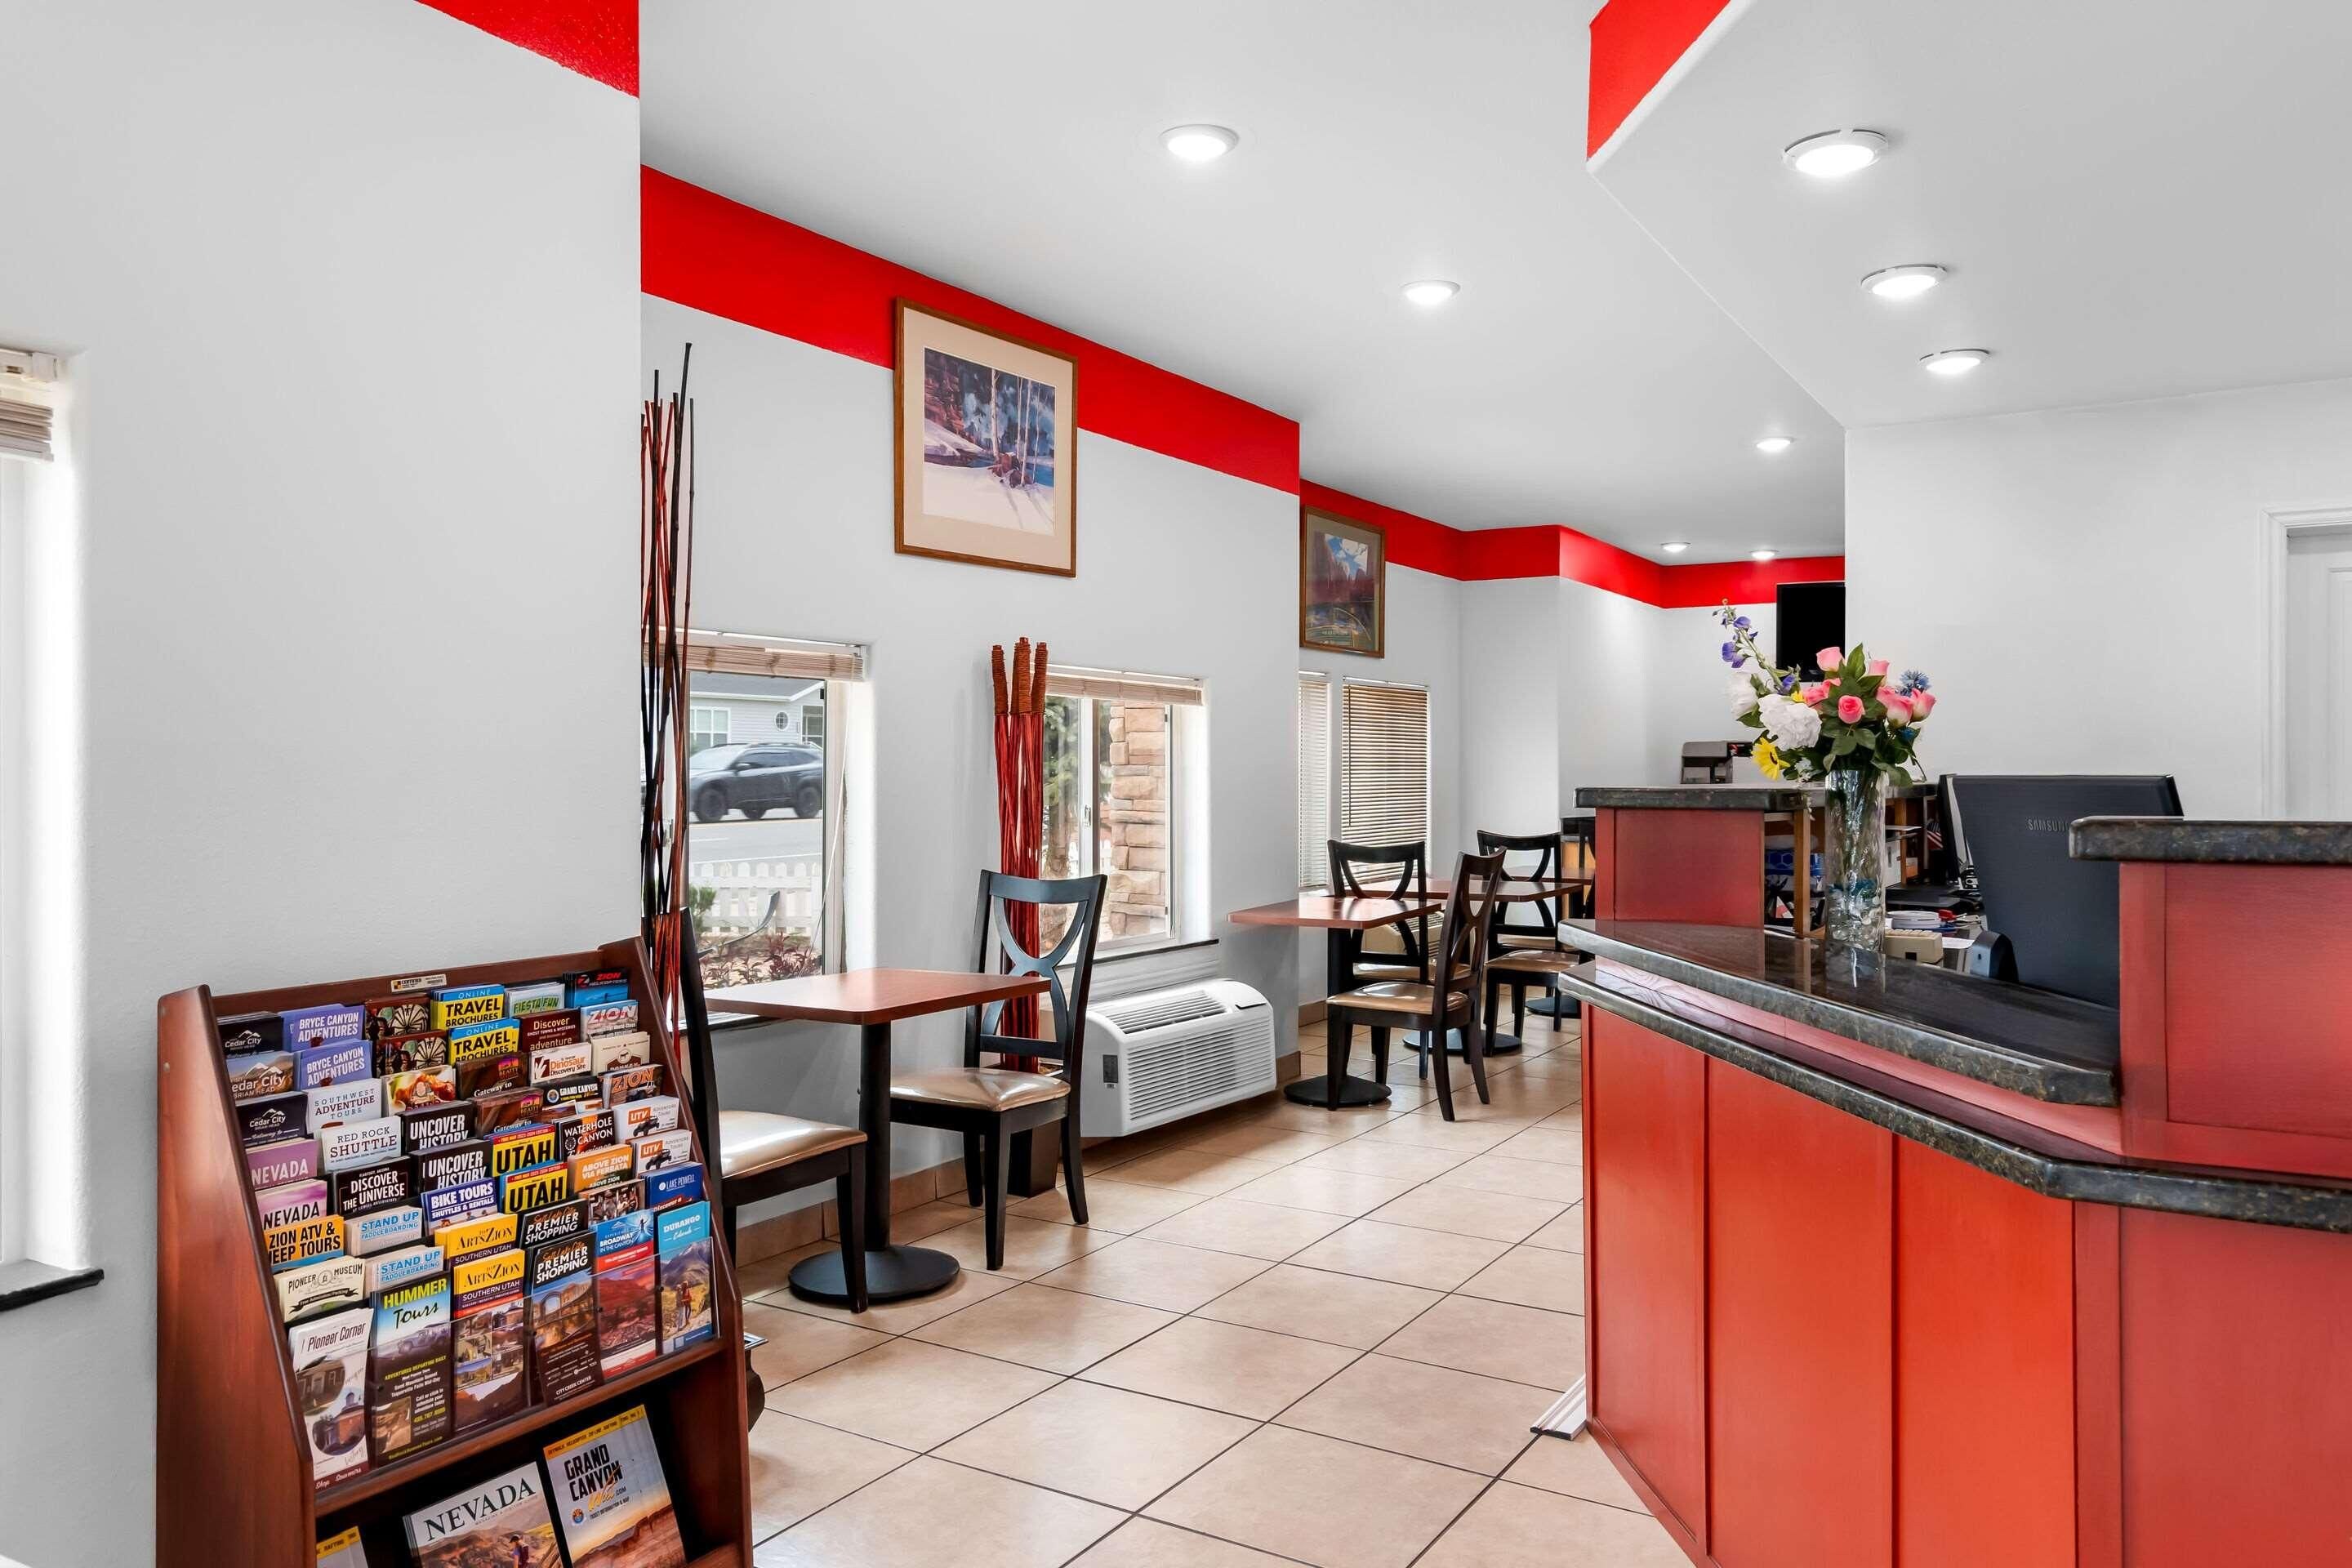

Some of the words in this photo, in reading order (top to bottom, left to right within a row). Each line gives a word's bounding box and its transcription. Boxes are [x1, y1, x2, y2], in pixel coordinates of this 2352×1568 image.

[596, 972, 621, 980] ZION
[459, 989, 490, 999] ONLINE
[446, 998, 500, 1017] TRAVEL
[514, 998, 541, 1013] FIESTA
[543, 997, 559, 1008] FUN
[588, 1005, 637, 1023] ZION
[299, 1016, 326, 1029] BRYCE
[327, 1012, 359, 1024] CANYON
[446, 1012, 498, 1027] BROCHURES
[466, 1022, 500, 1036] ONLINE
[533, 1018, 570, 1030] Discover
[225, 1040, 245, 1048] Cedar
[247, 1037, 261, 1045] City
[298, 1023, 358, 1042] ADVENTURES
[454, 1031, 510, 1054] TRAVEL
[455, 1045, 509, 1062] BROCHURES
[530, 1037, 572, 1051] adventure
[307, 1059, 332, 1074] BRYCE
[332, 1046, 363, 1064] CANYON
[550, 1057, 585, 1069] Dinosaur
[307, 1058, 365, 1086] ADVENTURES
[550, 1067, 575, 1076] Discovery
[613, 1067, 653, 1093] ZION
[232, 1080, 259, 1092] edar
[261, 1075, 286, 1087] City
[256, 1086, 276, 1095] HEAD
[474, 1084, 503, 1098] Gateway
[505, 1081, 513, 1090] to
[559, 1086, 577, 1096] GRAND
[578, 1083, 598, 1094] CANYON
[314, 1089, 375, 1106] SOUTHWEST
[314, 1095, 375, 1116] ADVENTURE
[249, 1119, 270, 1128] Cedar
[272, 1116, 286, 1124] City
[331, 1108, 363, 1119] TOURS
[630, 1111, 648, 1121] UTV
[337, 1132, 358, 1143] RED
[361, 1126, 390, 1138] ROCK
[410, 1114, 466, 1140] UNCOVER
[564, 1116, 612, 1138] WATERHOLE
[577, 1128, 612, 1145] CANYON
[330, 1134, 398, 1158] SHUTTLE
[644, 1143, 660, 1155] UTV
[429, 1150, 483, 1177] UNCOVER
[497, 1139, 551, 1174] UTAH
[582, 1160, 610, 1171] ABOVE
[612, 1154, 629, 1165] ZION
[252, 1158, 309, 1185] NEVADA
[437, 1166, 487, 1190] HISTORY
[582, 1169, 596, 1178] VIA
[597, 1164, 628, 1176] FERRATA
[351, 1170, 399, 1194] DISCOVER
[666, 1178, 678, 1190] LAKE
[678, 1174, 695, 1186] POWELL
[343, 1198, 358, 1211] THE
[359, 1183, 405, 1205] UNIVERSE
[431, 1187, 457, 1209] BIKE
[458, 1183, 493, 1201] TOURS
[509, 1176, 563, 1212] UTAH
[264, 1201, 319, 1230] NEVADA
[432, 1205, 461, 1219] SHUTTLES
[469, 1196, 494, 1209] RENTALS
[361, 1215, 399, 1232] STAND
[403, 1211, 419, 1222] UP
[527, 1212, 579, 1234] PREMIER
[663, 1214, 701, 1232] DURANGO
[269, 1230, 296, 1250] ZION
[300, 1225, 323, 1243] ATV
[326, 1222, 335, 1235] &
[361, 1223, 419, 1241] PADDLEBOARDING
[525, 1222, 578, 1245] SHOPPING
[600, 1232, 634, 1247] BROADWAY
[300, 1235, 341, 1257] TOURS
[455, 1249, 493, 1264] SOUTHERN
[493, 1244, 512, 1254] UTAH
[614, 1240, 634, 1249] CANYON
[381, 1256, 421, 1274] STAND
[425, 1251, 441, 1262] UP
[537, 1245, 588, 1274] PREMIER
[287, 1274, 317, 1294] PIONEER
[333, 1263, 363, 1276] MUSEUM
[380, 1261, 440, 1282] PADDLEBOARDING
[536, 1256, 589, 1284] SHOPPING
[383, 1277, 448, 1309] HUMMER
[463, 1285, 501, 1302] SOUTHERN
[501, 1280, 520, 1291] UTAH
[393, 1302, 439, 1330] Tours
[308, 1331, 339, 1352] Pioneer
[339, 1323, 366, 1341] Corner
[564, 1444, 610, 1481] GRAND
[568, 1460, 623, 1502] CANYON
[616, 1486, 626, 1497] .COM
[423, 1477, 537, 1541] NEVADA
